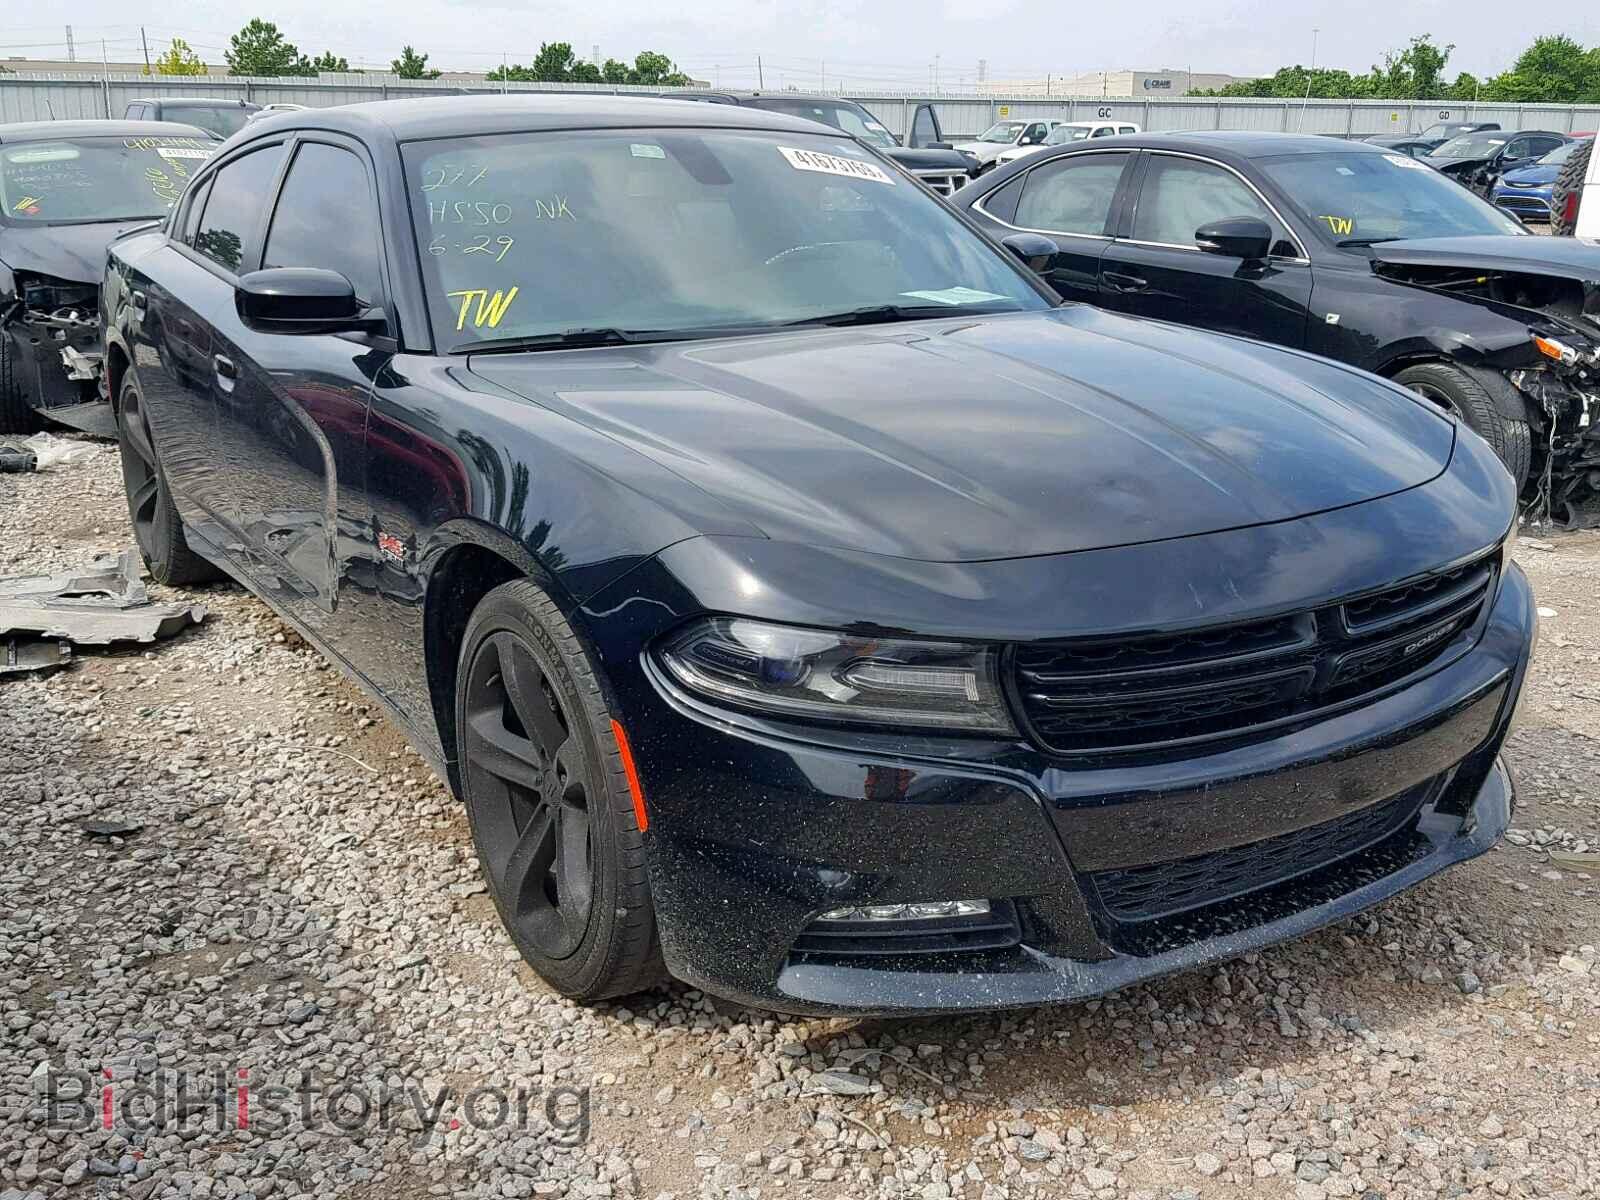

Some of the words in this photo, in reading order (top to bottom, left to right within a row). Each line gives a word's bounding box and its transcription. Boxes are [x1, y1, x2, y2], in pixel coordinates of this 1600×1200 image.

[1098, 107, 1112, 118] GC
[1439, 111, 1450, 120] GD
[535, 194, 577, 222] NK
[1318, 215, 1352, 235] TW
[447, 286, 519, 331] TW
